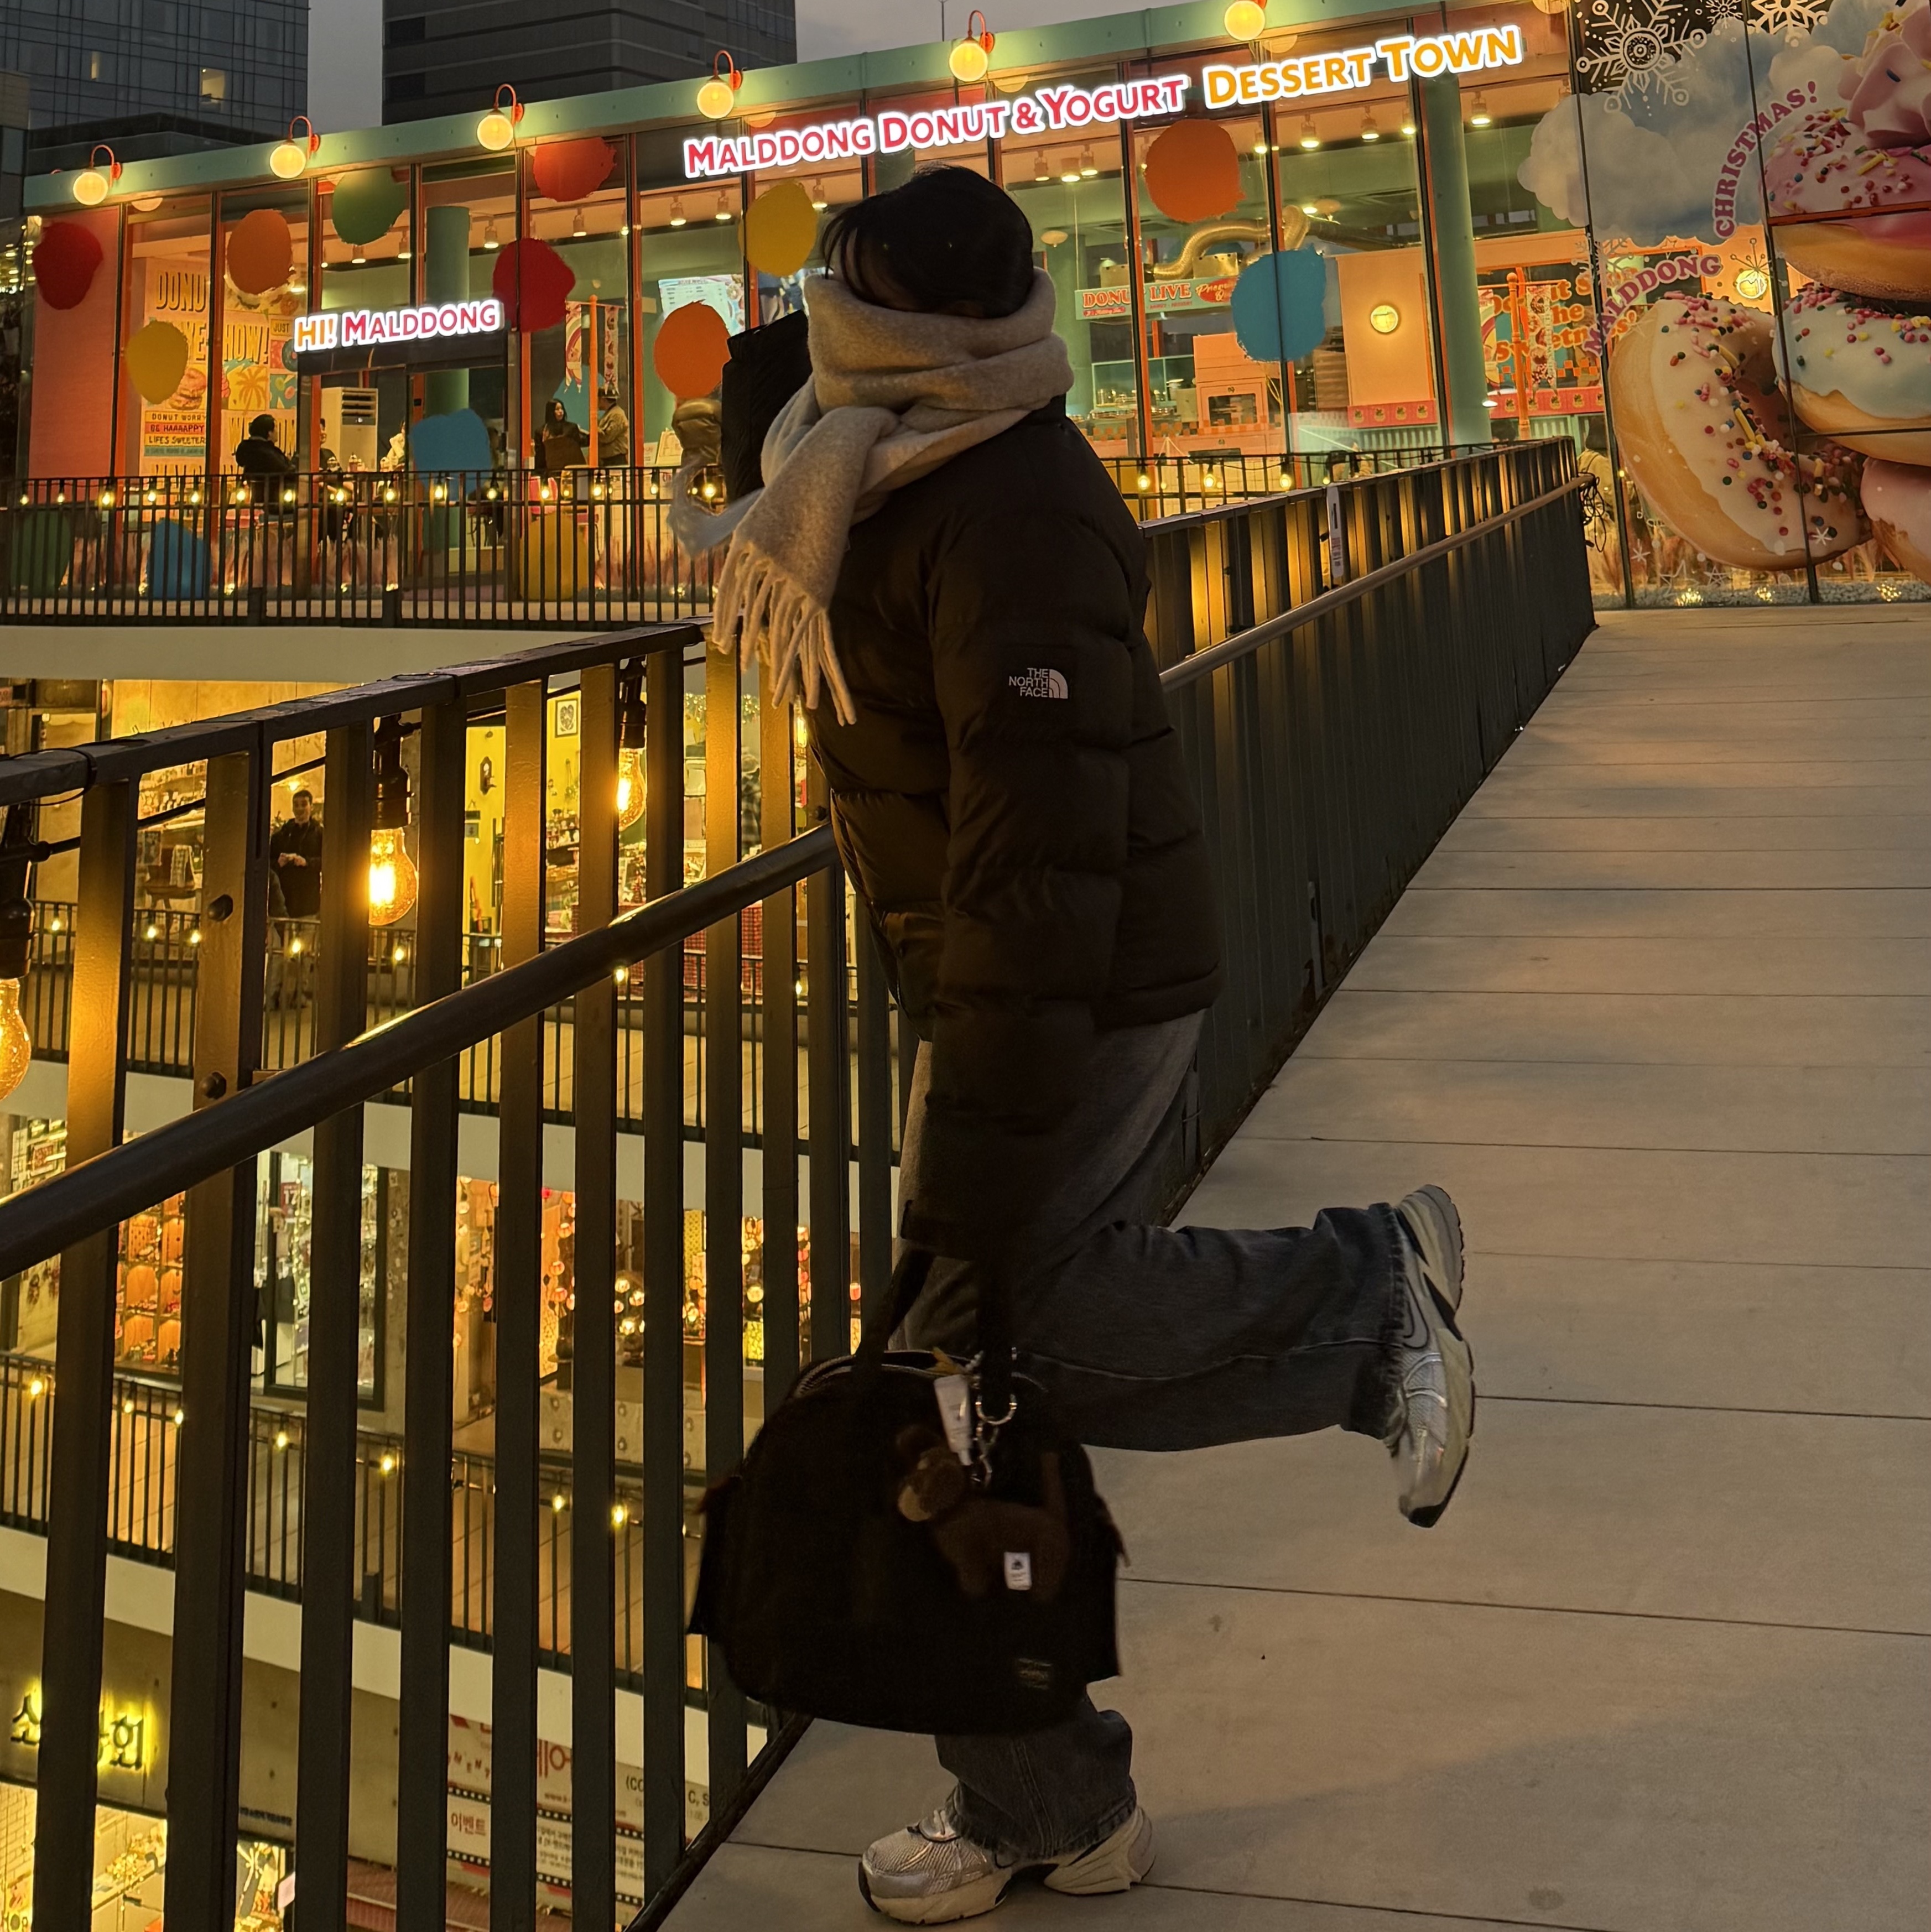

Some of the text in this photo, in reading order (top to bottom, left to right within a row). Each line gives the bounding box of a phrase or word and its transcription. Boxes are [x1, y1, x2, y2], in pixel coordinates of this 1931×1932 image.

[1206, 29, 1519, 106] DESSERT TOWN
[686, 77, 1186, 176] MALDDONG DONUT & YOGURT
[1714, 80, 1818, 238] CHRISTMAS!
[156, 270, 207, 313] DONU
[1082, 288, 1131, 308] DONU
[1149, 282, 1191, 302] LIVE
[1584, 256, 1721, 354] MALDDONG
[273, 322, 289, 332] JUST
[296, 301, 498, 349] HI! MALDDONG
[1009, 676, 1048, 689] NORTH
[1027, 668, 1048, 678] THE
[1020, 686, 1048, 697] FACE
[451, 1808, 487, 1836] 이벤트
